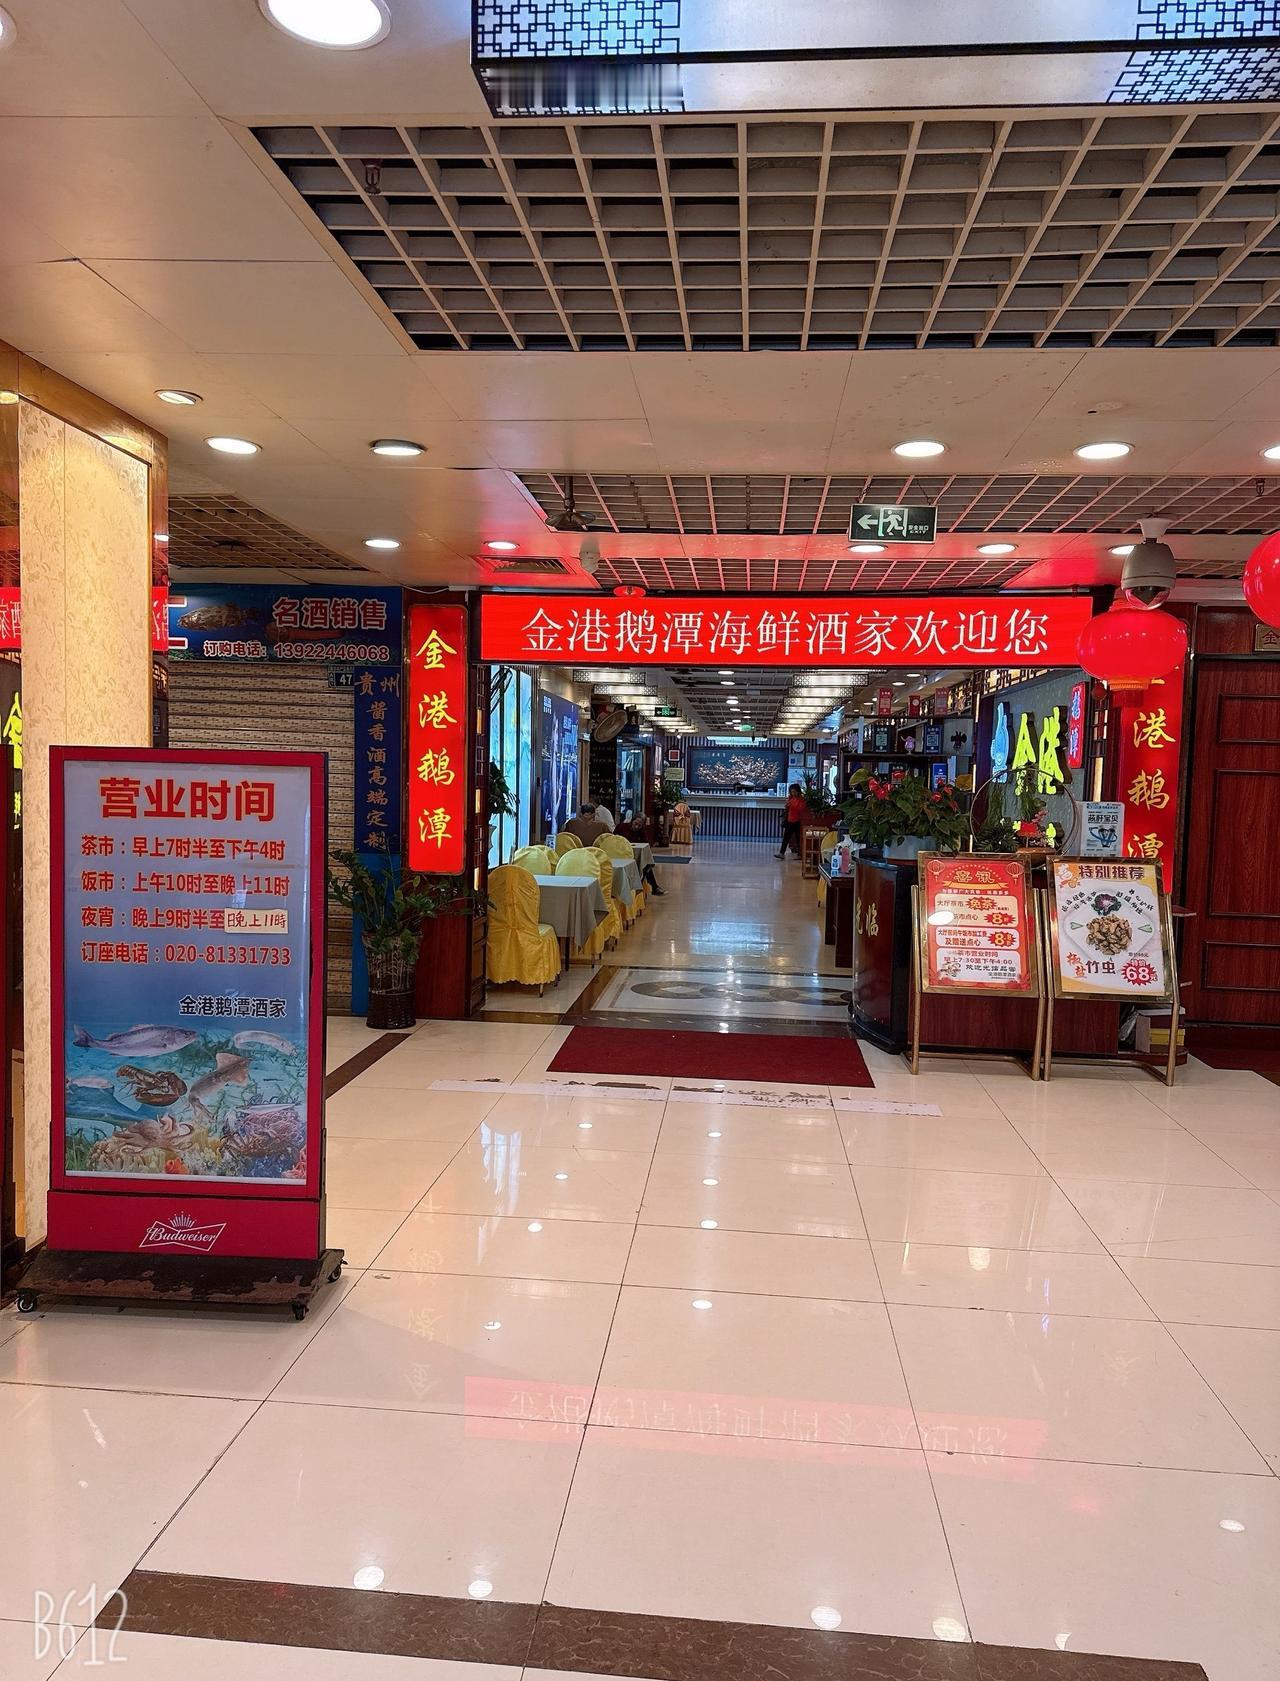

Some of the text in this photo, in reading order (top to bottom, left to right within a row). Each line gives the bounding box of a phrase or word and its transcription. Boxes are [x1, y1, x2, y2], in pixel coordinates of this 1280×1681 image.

[272, 597, 388, 630] 名酒销售
[520, 606, 1049, 656] 金港鹅潭海鲜酒家欢迎您
[98, 776, 275, 822] 营业时间
[1078, 865, 1145, 879] 特别推荐
[1085, 960, 1116, 975] 竹虫
[178, 995, 287, 1018] 金港鹅潭酒家
[146, 1227, 216, 1242] Budweiser
